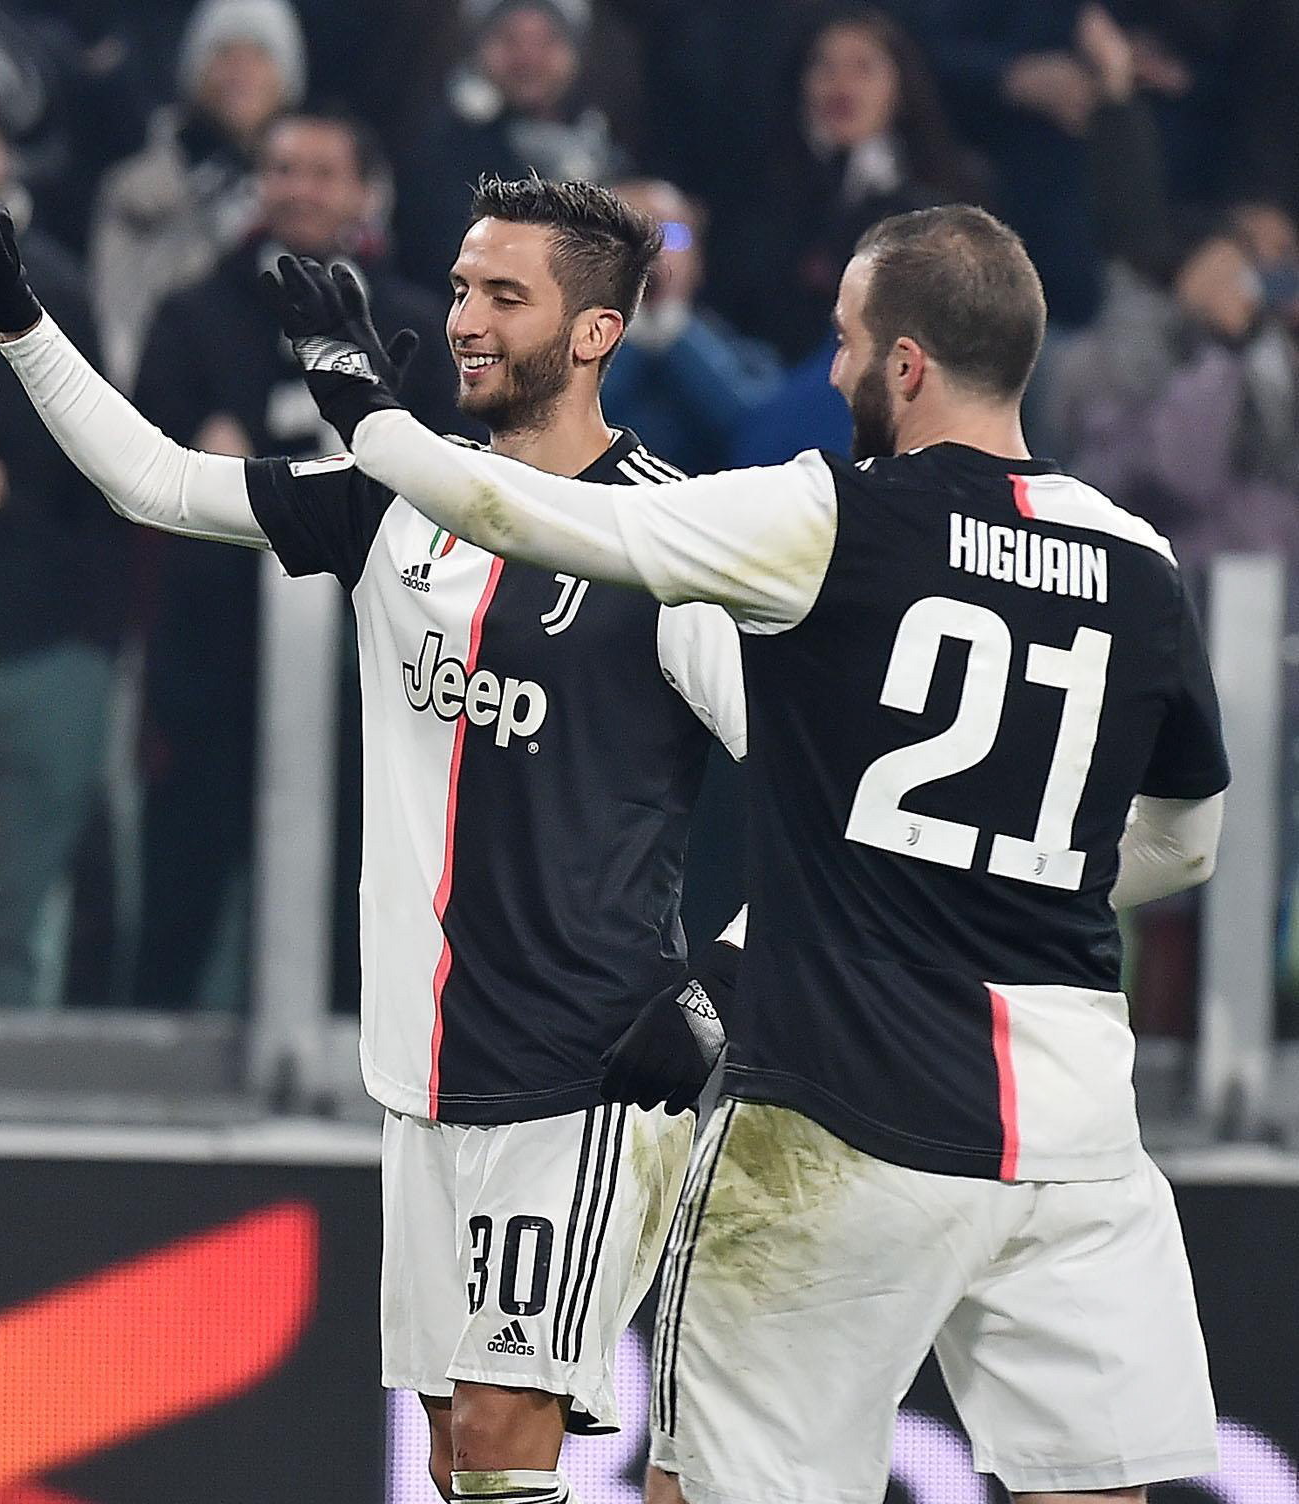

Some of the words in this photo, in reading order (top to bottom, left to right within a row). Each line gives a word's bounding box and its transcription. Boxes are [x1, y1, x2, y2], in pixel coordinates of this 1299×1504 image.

[949, 512, 1108, 603] HIGUAIN
[402, 630, 549, 748] Jeep
[844, 596, 1112, 891] 21
[467, 1215, 555, 1317] 30
[487, 1340, 535, 1356] adidas
